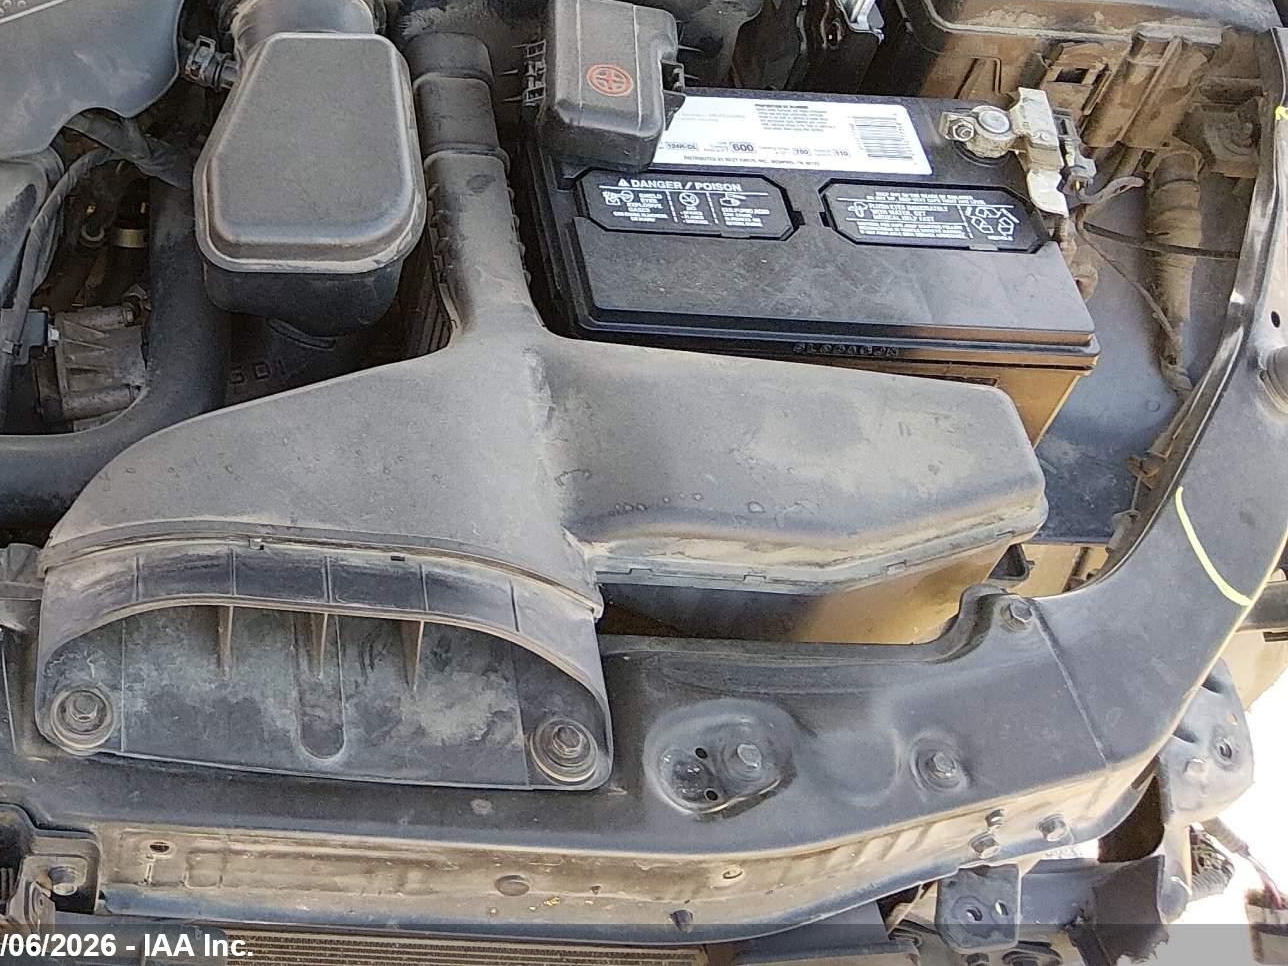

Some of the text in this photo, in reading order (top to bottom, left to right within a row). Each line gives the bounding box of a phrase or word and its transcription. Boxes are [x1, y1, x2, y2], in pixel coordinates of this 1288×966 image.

[731, 143, 754, 153] 600
[630, 179, 742, 192] DANGER / POISON
